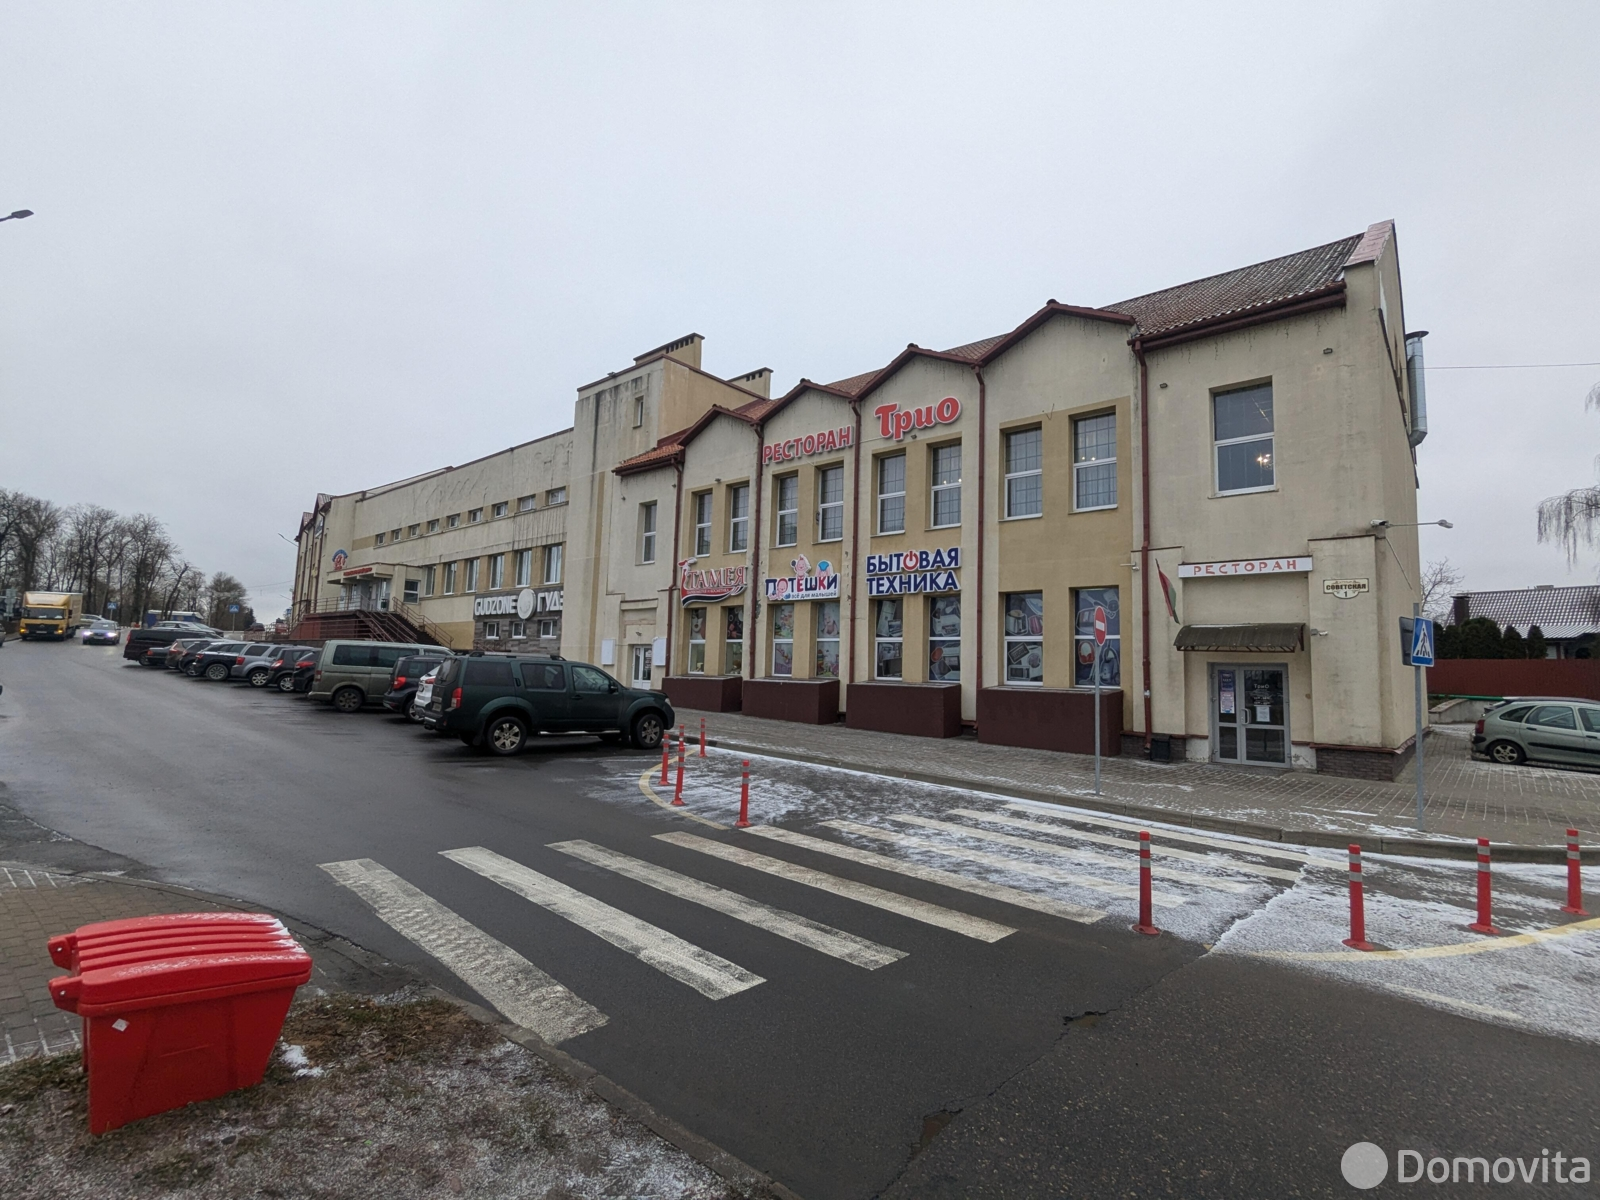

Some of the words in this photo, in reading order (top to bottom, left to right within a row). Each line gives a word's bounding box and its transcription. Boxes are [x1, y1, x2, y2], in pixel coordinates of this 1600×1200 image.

[763, 426, 851, 464] РЕСТОРАН
[866, 547, 959, 574] БЫТОВАЯ
[1193, 559, 1297, 576] РЕСТОРАН
[688, 566, 748, 589] ТАМЕЯ
[866, 571, 958, 595] ТЕХНИКА
[1325, 583, 1367, 591] СОВЕТСКАЯ
[1343, 590, 1348, 598] 1
[475, 595, 518, 616] GUDZONE
